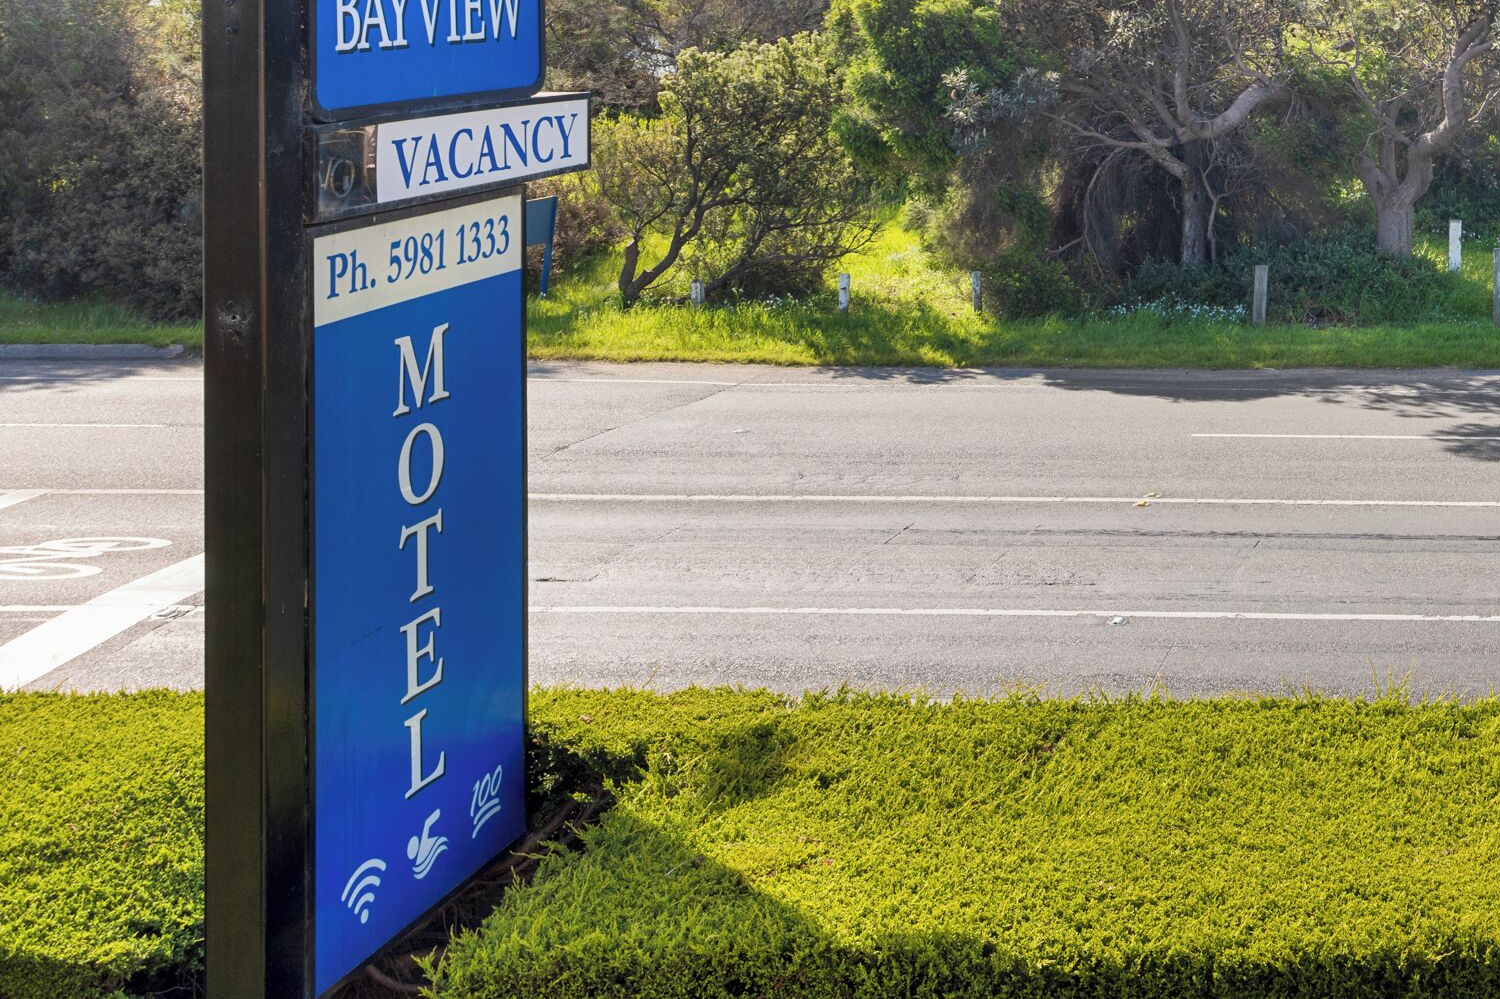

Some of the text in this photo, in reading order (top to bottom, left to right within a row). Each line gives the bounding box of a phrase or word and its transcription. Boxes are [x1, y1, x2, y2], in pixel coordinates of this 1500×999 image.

[392, 113, 577, 189] VACANCY
[327, 214, 510, 299] Ph. 5981 1333
[393, 322, 450, 800] MOTEL
[470, 764, 503, 818] 100
